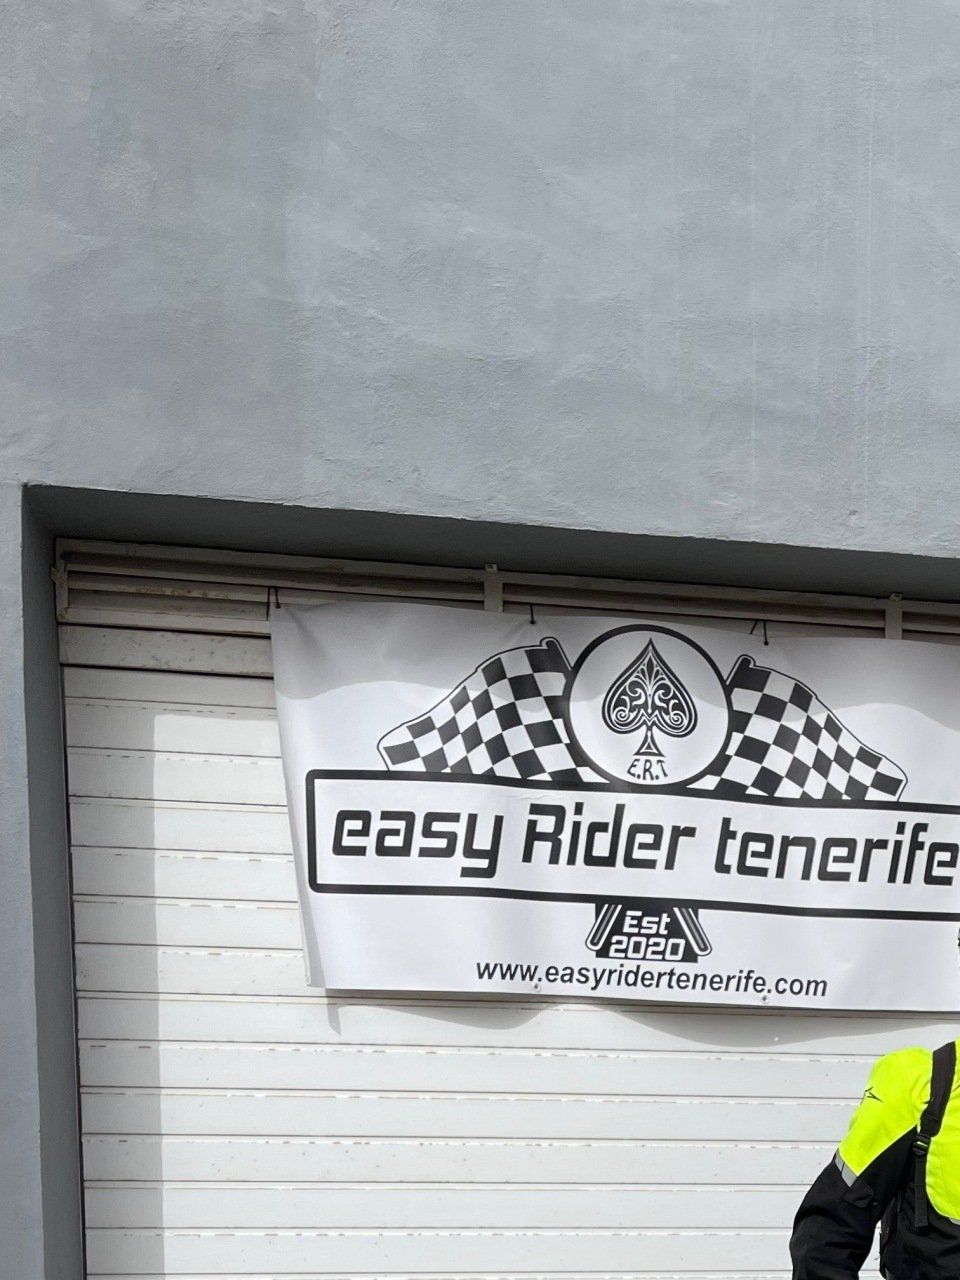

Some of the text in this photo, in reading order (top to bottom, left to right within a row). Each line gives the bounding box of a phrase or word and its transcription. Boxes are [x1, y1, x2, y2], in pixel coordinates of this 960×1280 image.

[627, 758, 668, 781] E.R.T
[332, 801, 960, 887] easy Rider tenerife
[622, 910, 671, 935] Est
[608, 935, 686, 961] 2020
[475, 961, 829, 998] www.easyridertenerife.com
